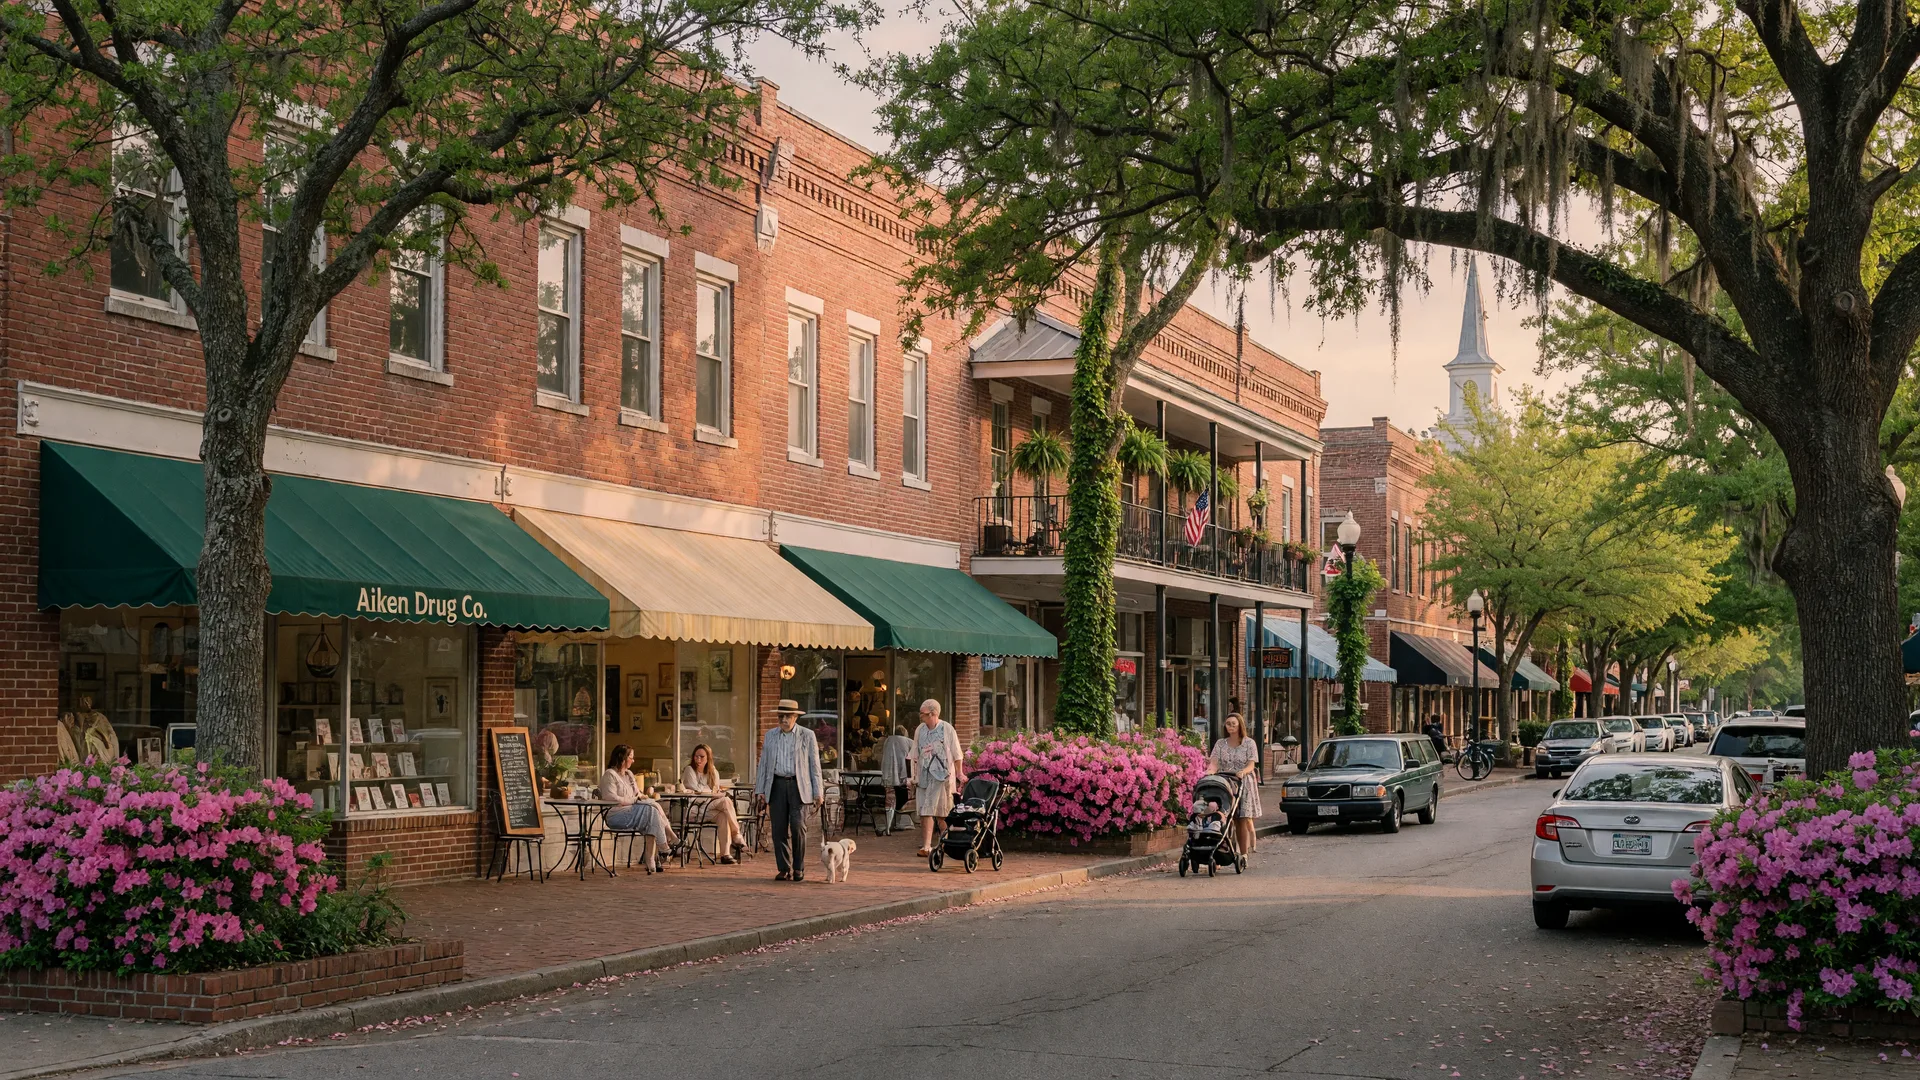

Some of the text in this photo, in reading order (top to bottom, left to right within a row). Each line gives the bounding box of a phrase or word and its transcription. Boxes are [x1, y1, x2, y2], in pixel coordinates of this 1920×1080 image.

[356, 587, 488, 623] Aiken Drug Co.
